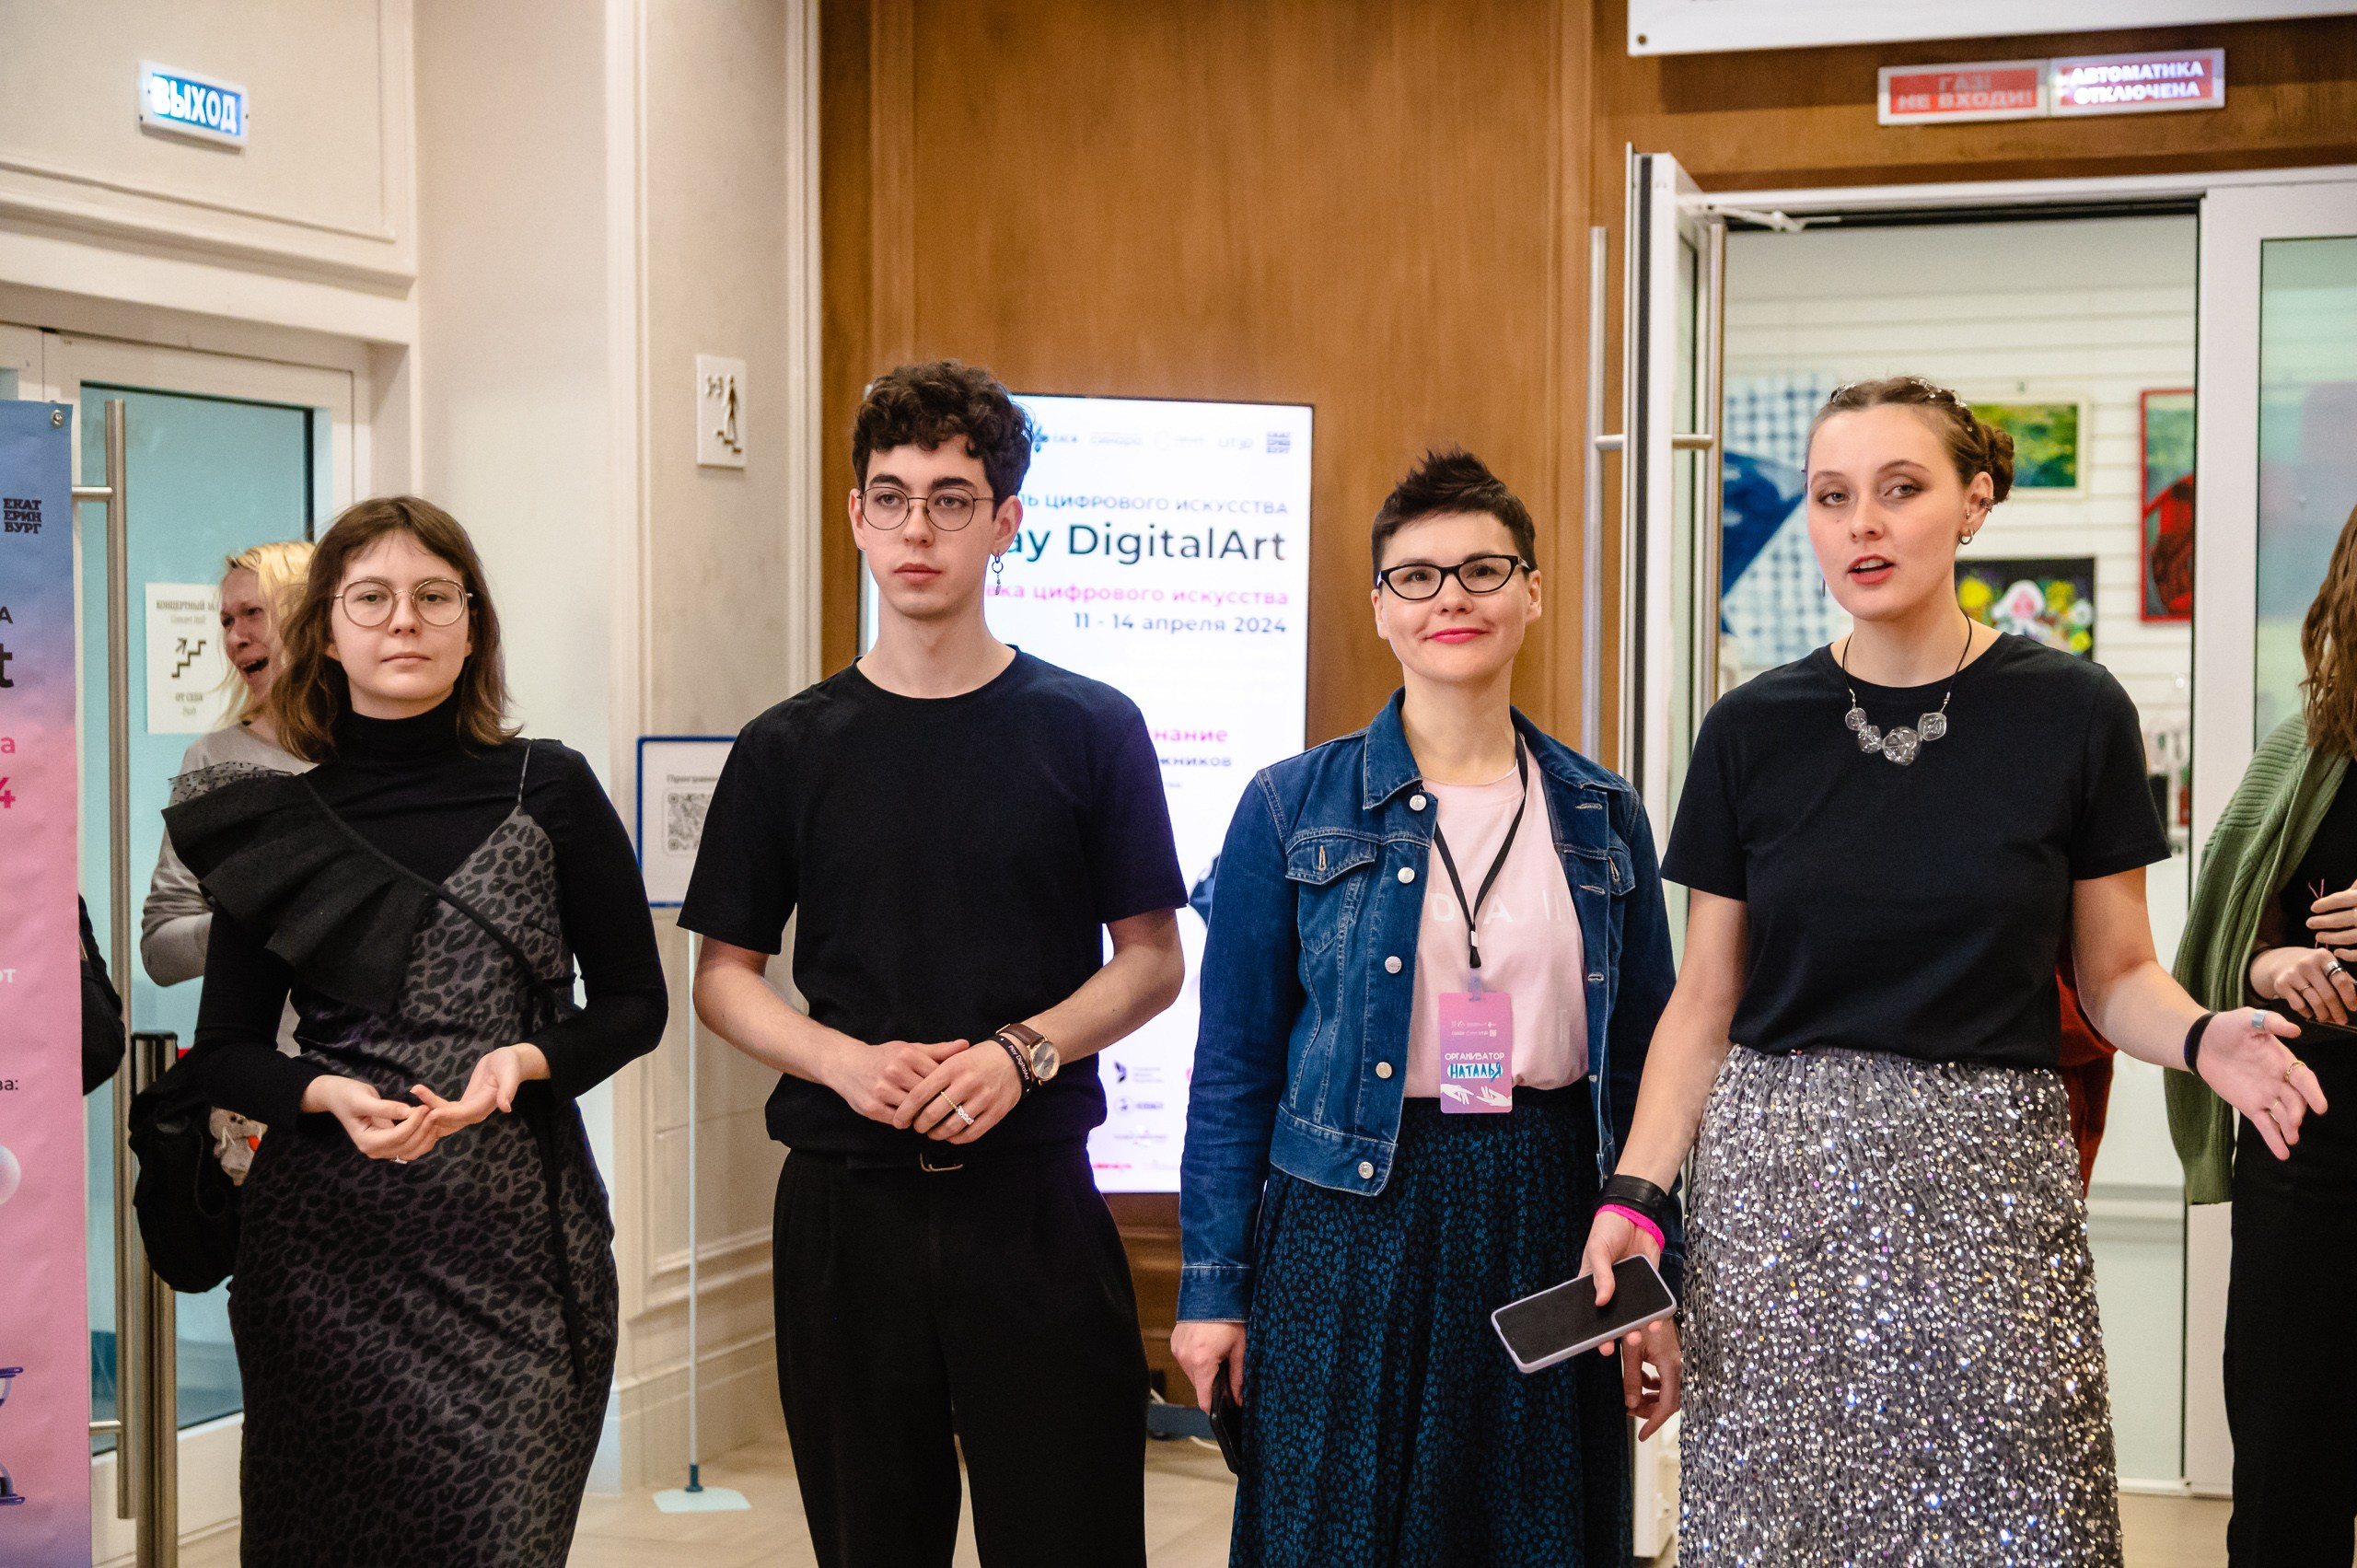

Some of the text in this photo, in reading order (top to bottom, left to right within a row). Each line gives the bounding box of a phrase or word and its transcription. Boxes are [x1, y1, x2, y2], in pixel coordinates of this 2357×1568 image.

[2072, 61, 2204, 86] АВТОМАТИКА
[1898, 89, 2033, 110] НЕ ВХОДИ!
[2073, 81, 2200, 104] ОТКЛЮЧЕНА
[151, 76, 237, 134] ВЫХОД
[3, 498, 42, 511] ЕКАТ
[1045, 494, 1169, 512] ЦИФРОВОГО
[1176, 499, 1288, 515] ИСКУССТВА
[4, 510, 42, 522] ЕРИН
[5, 522, 42, 534] БУРГ
[1007, 522, 1285, 565] ay DigitalArt
[986, 583, 1288, 608] вка цифрового искусства
[1074, 611, 1089, 629] 11
[1112, 613, 1134, 629] 14
[1142, 617, 1225, 634] апреля
[1234, 616, 1286, 633] 2024
[1154, 728, 1228, 742] нание
[1159, 756, 1232, 767] жников
[1445, 1052, 1504, 1061] ОРГАНИЗАТОР
[1449, 1062, 1502, 1083] НАТАЛЬЯ
